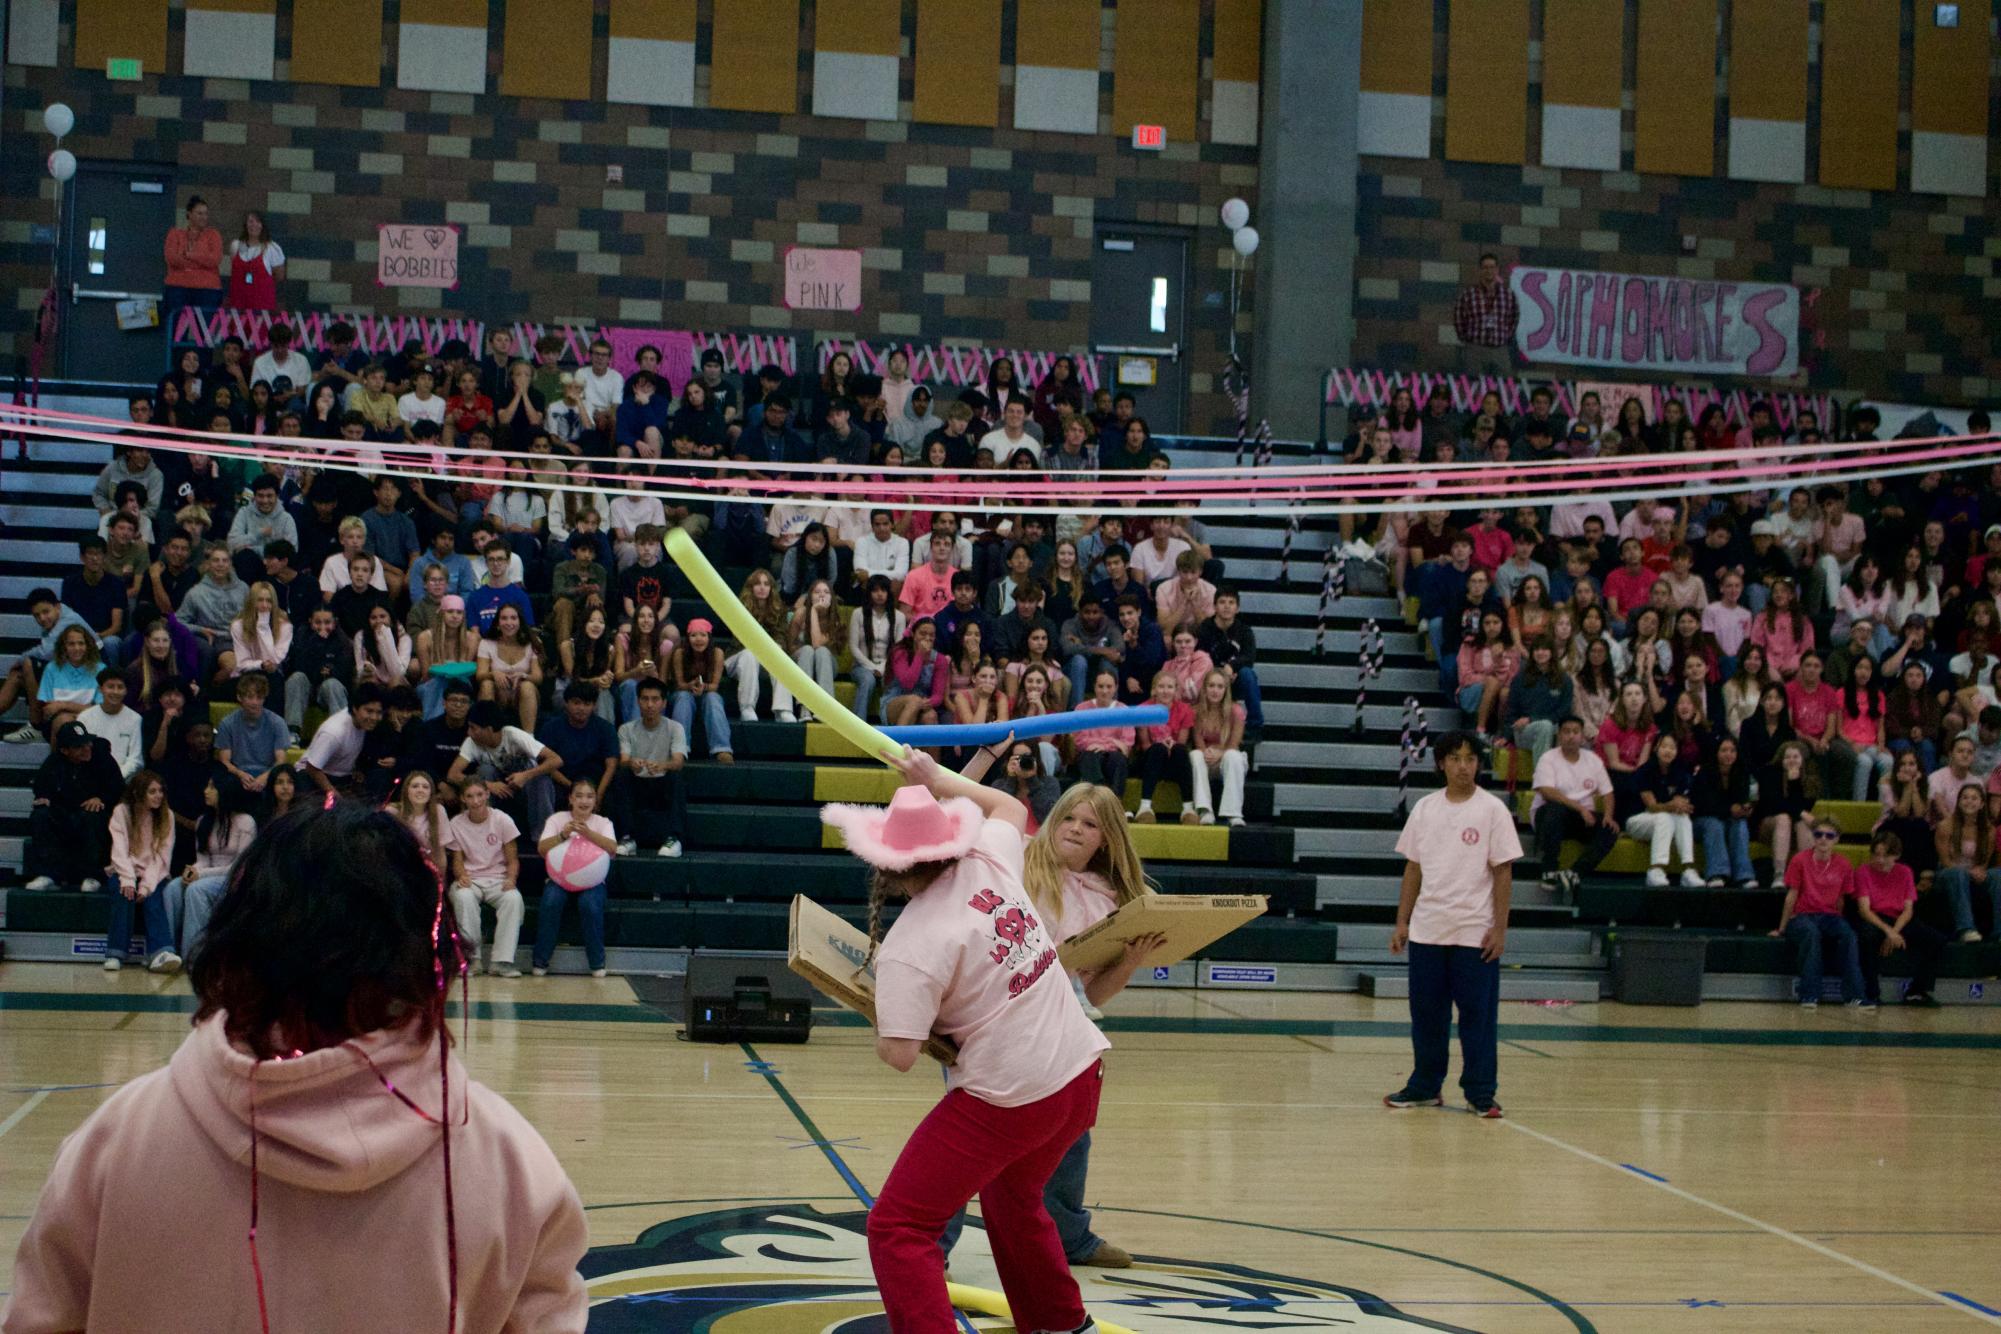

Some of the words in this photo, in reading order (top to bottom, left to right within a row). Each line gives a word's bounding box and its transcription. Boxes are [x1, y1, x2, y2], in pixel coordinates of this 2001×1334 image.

[1138, 126, 1161, 145] EXIT
[386, 228, 413, 250] WE
[384, 256, 456, 280] BOBBIES
[800, 281, 846, 309] PINK
[1520, 271, 1787, 374] SOPHOMORES
[967, 888, 1005, 915] WE
[1211, 898, 1240, 908] KNOCKOUT
[1240, 899, 1258, 908] PIZZA
